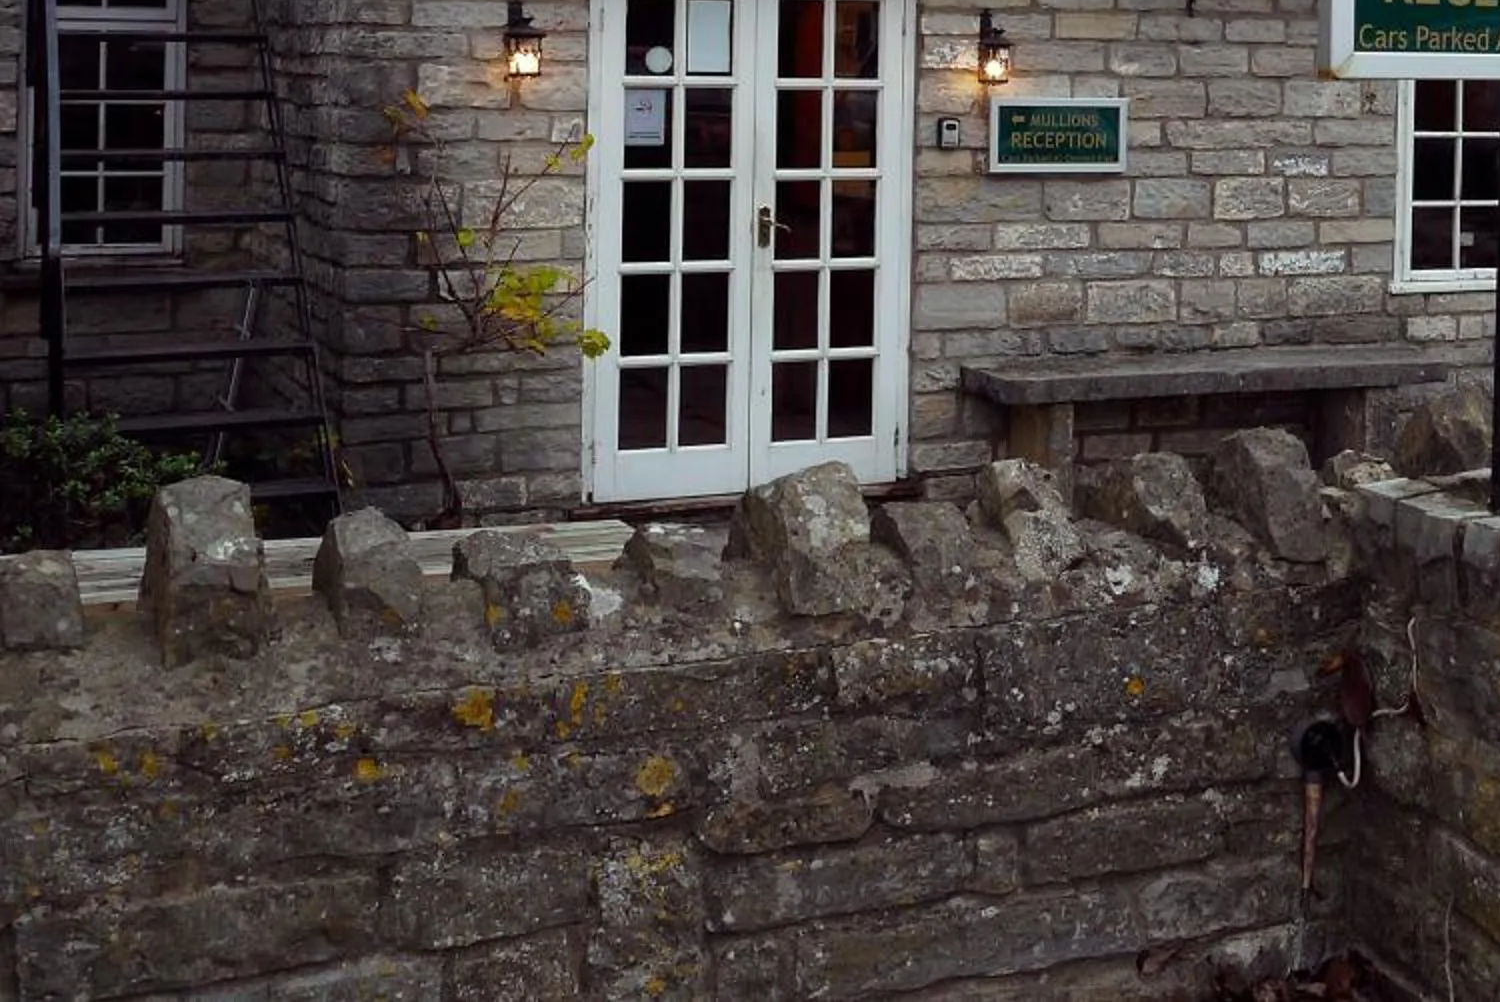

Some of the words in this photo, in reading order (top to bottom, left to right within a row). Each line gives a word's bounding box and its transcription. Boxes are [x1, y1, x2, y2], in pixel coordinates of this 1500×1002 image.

[1359, 23, 1408, 50] Cars
[1416, 25, 1489, 52] Parked
[1030, 114, 1099, 126] MULLIONS
[1011, 131, 1107, 149] RECEPTION
